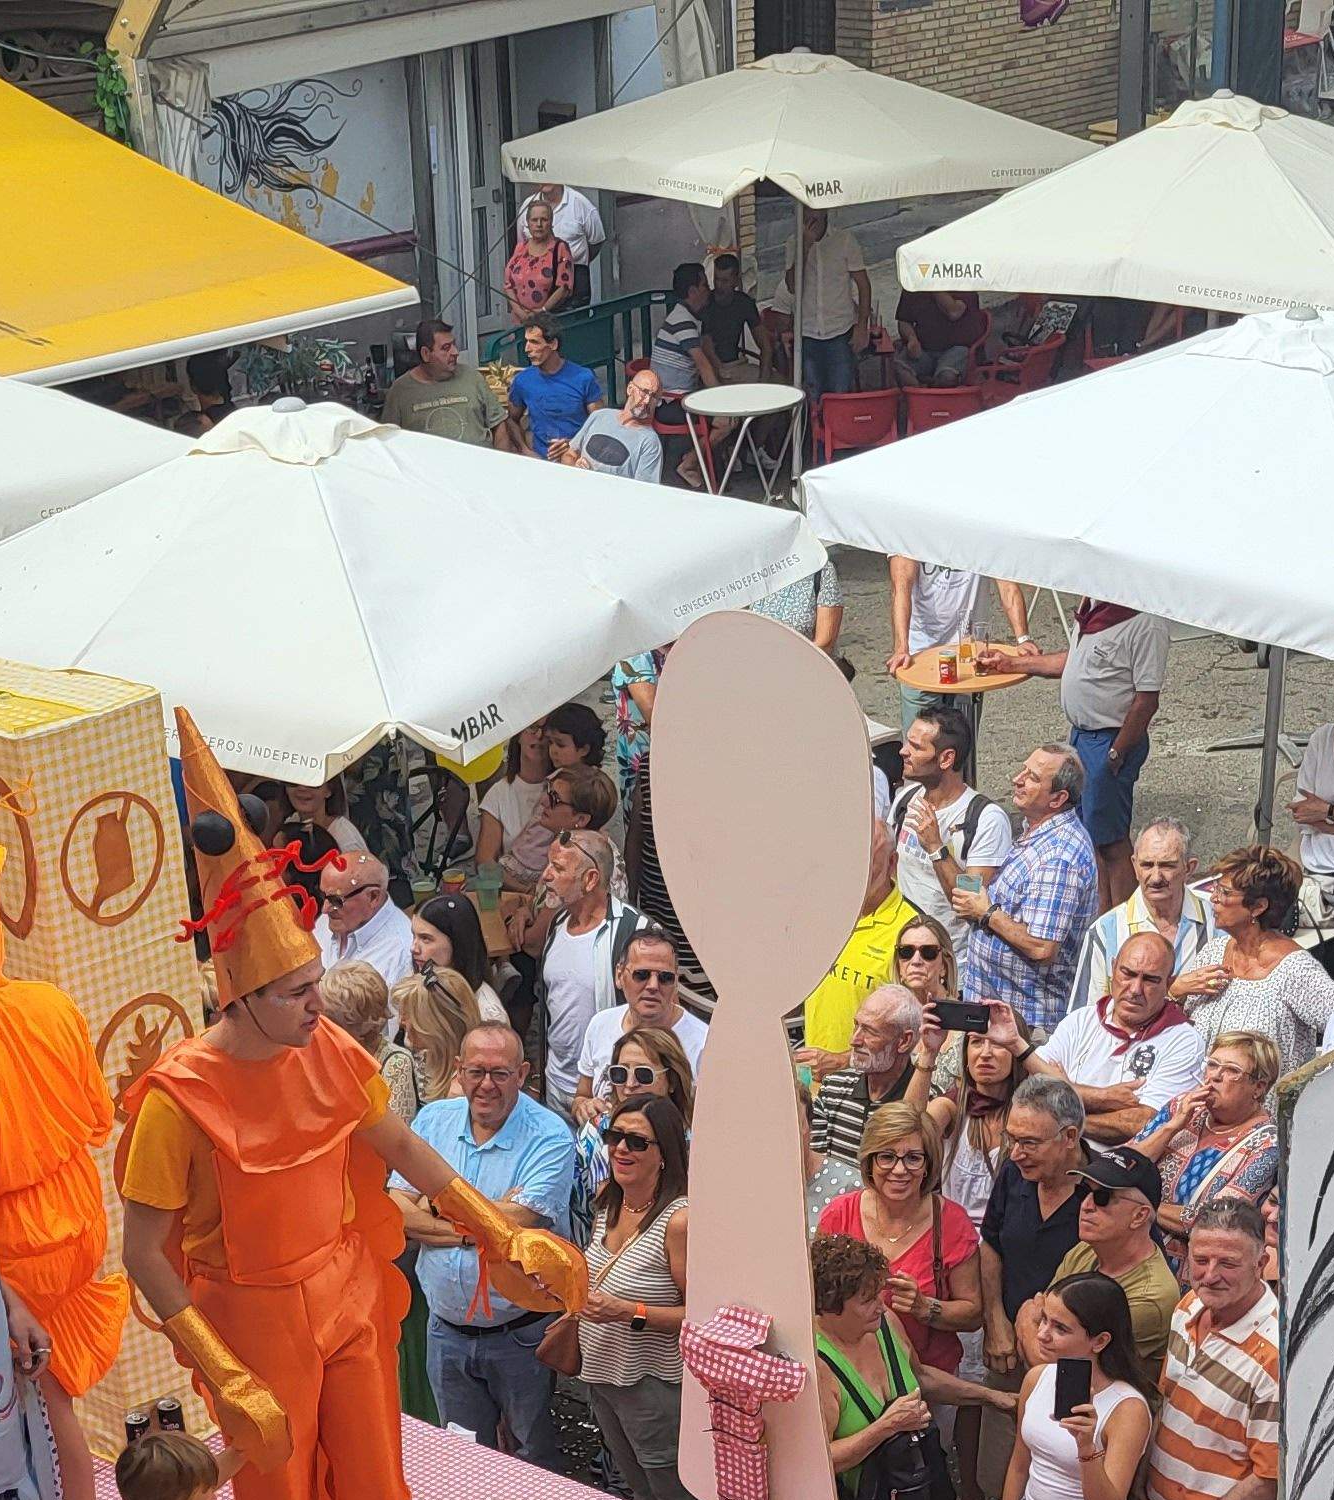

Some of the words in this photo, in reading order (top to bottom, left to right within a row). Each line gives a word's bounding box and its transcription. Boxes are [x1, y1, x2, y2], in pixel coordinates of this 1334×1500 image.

[517, 156, 547, 173] AMBAR
[805, 179, 843, 198] MBAR
[931, 262, 983, 279] AMBAR
[1177, 284, 1243, 301] CERVECEROS
[673, 587, 726, 618] CERVECEROS
[727, 553, 801, 594] INDEPENDIENTES
[450, 703, 504, 743] MBAR
[248, 744, 323, 770] INDEPENDI
[830, 964, 874, 990] KETT
